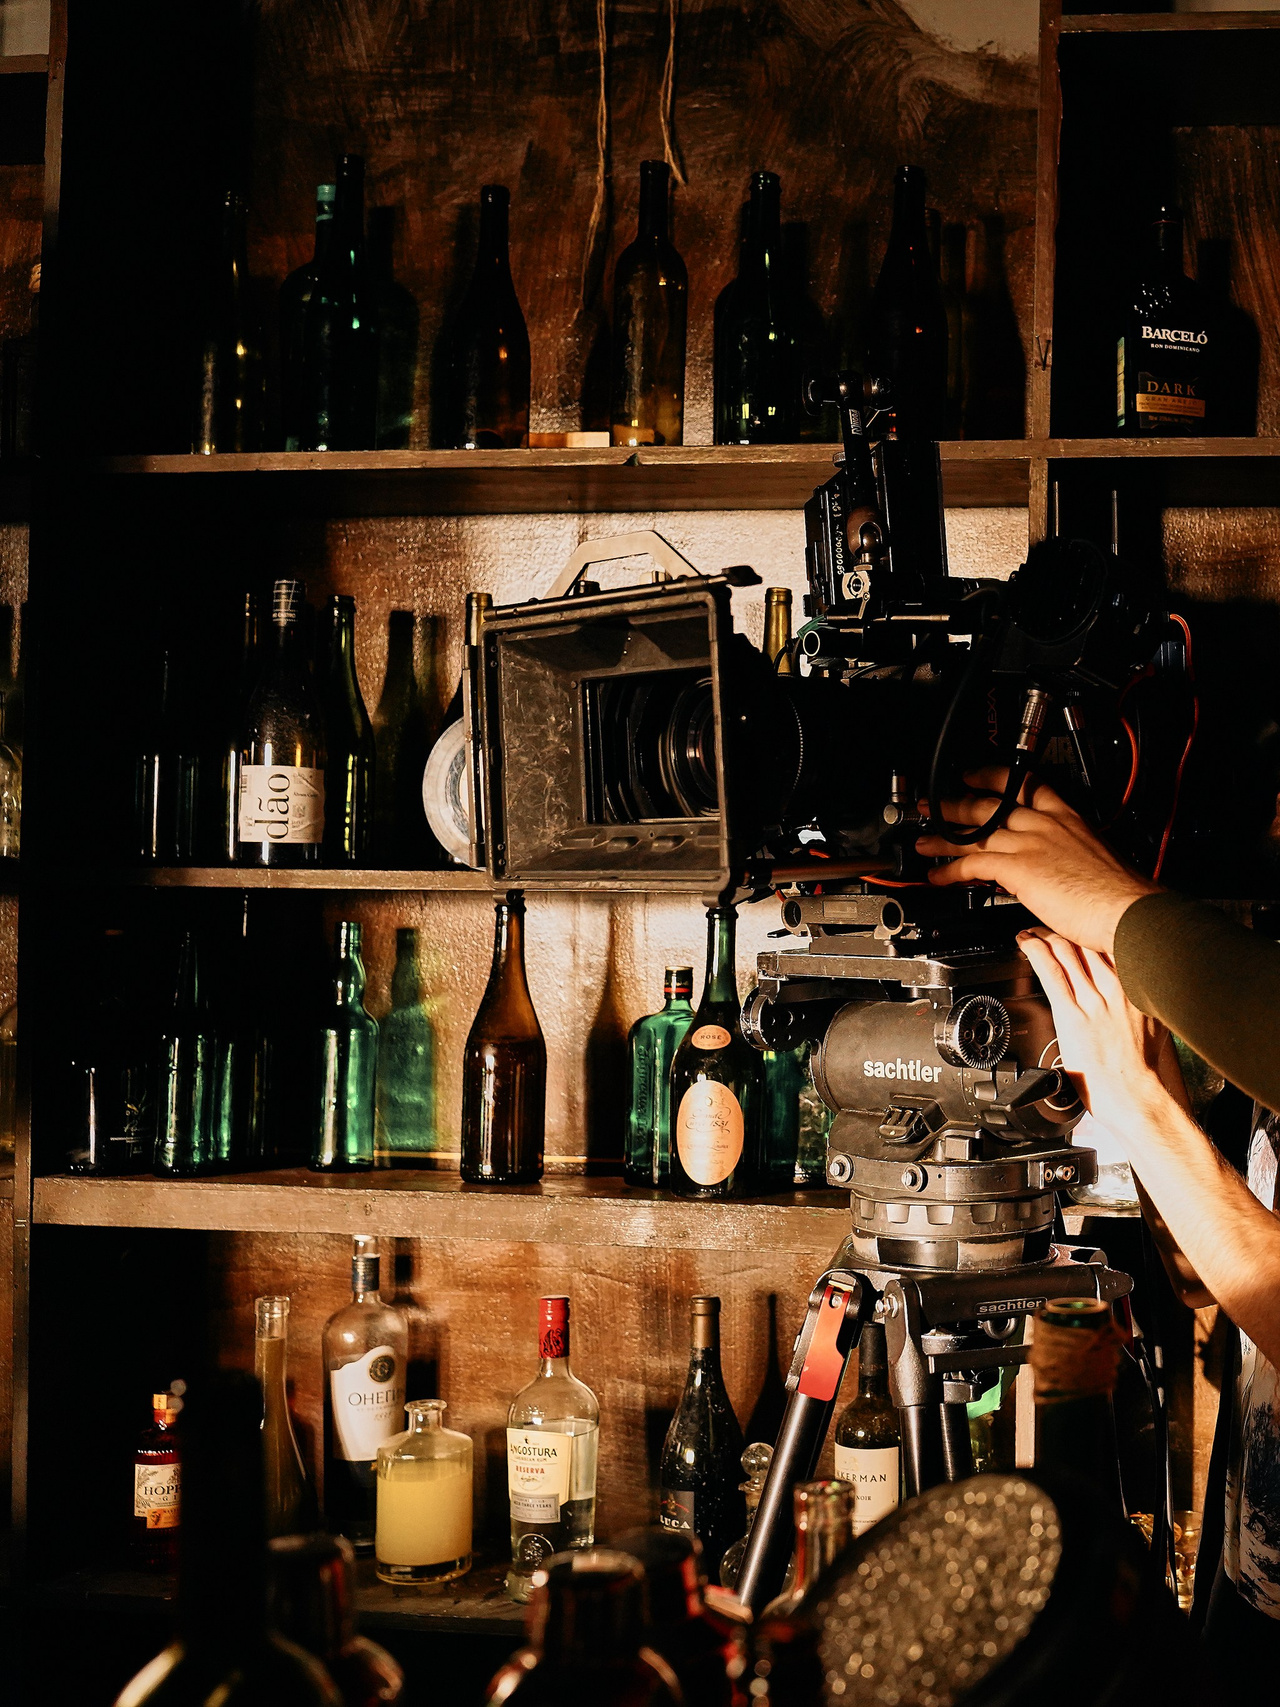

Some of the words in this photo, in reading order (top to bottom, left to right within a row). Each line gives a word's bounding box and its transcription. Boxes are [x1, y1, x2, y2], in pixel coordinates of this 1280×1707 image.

[1141, 325, 1208, 345] BARCELÓ
[1164, 345, 1200, 353] DOMINICANO
[1147, 380, 1196, 396] DARK
[254, 773, 291, 840] dão
[863, 1057, 943, 1083] sachtler
[979, 1300, 1042, 1313] sachtler
[510, 1443, 558, 1458] ANGOSTURA
[515, 1465, 545, 1474] RESERVA
